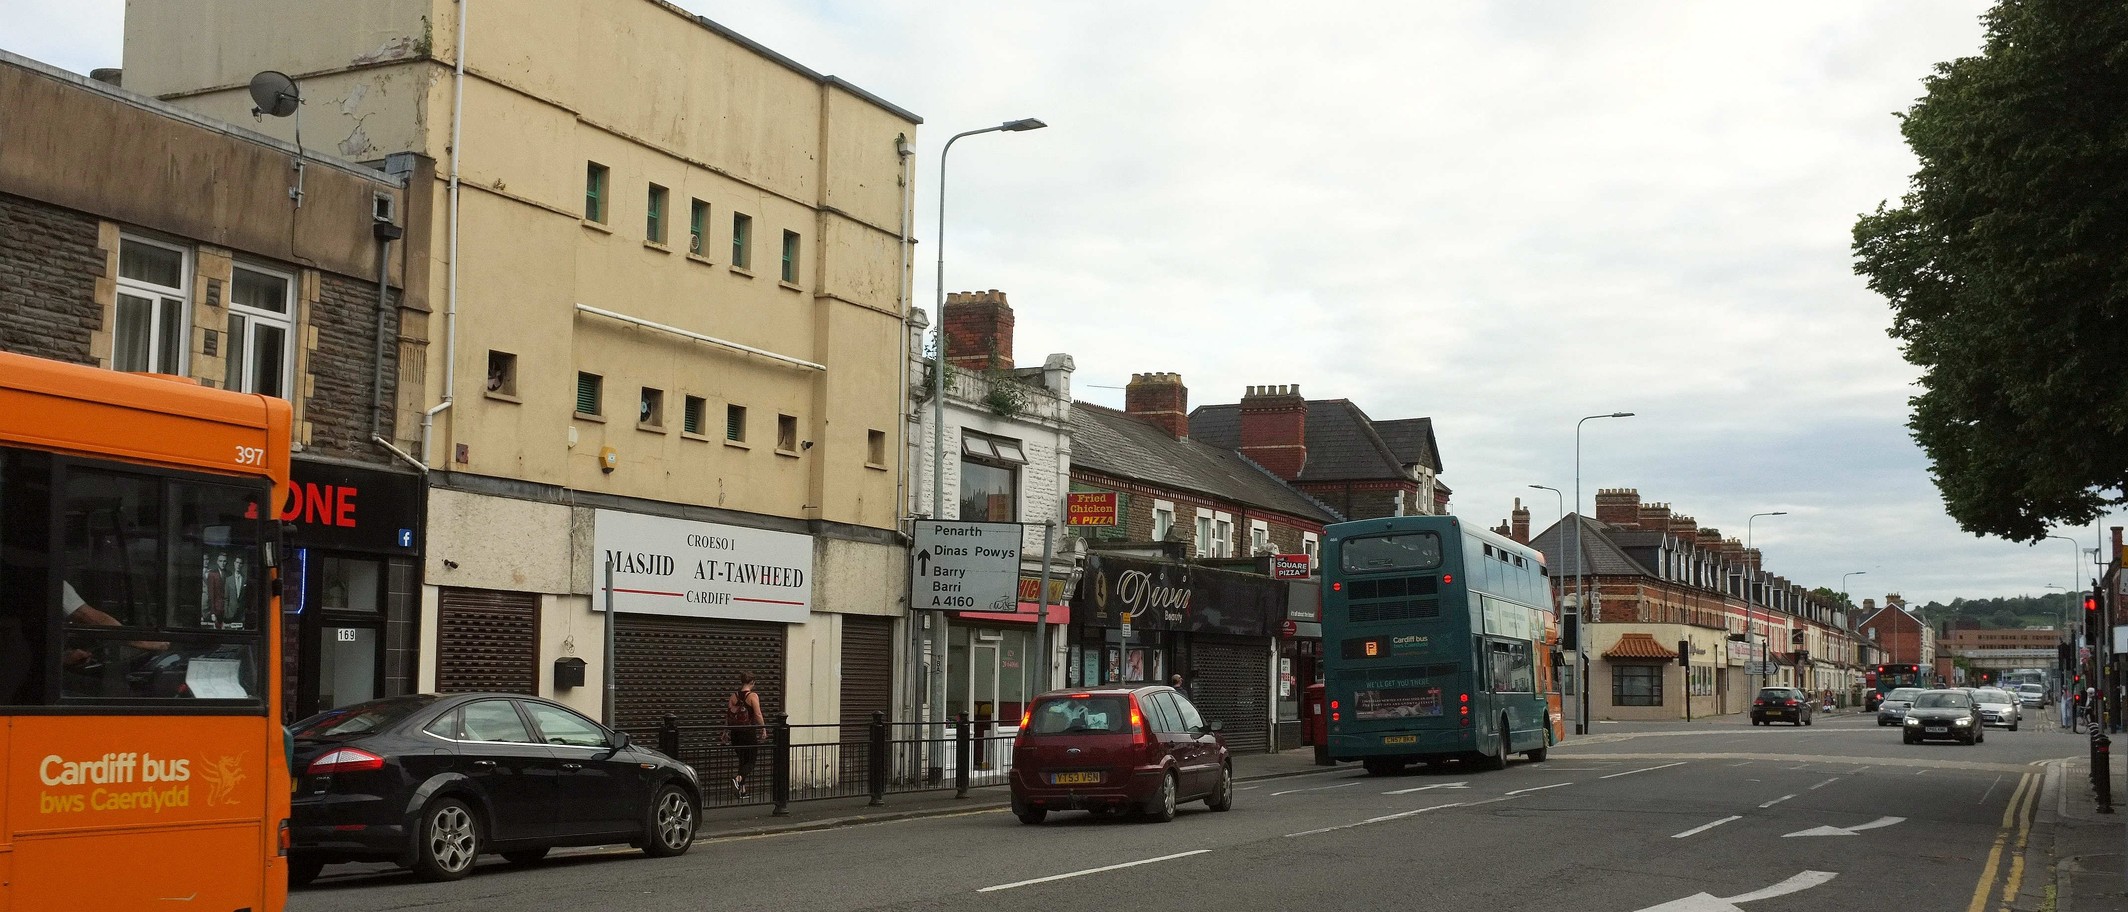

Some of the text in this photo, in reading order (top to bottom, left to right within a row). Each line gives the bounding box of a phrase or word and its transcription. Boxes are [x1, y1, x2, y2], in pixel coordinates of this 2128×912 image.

[235, 446, 264, 466] 397
[1077, 494, 1106, 503] Fried
[1070, 504, 1114, 513] Chicken
[1070, 516, 1114, 525] & PIZZA
[934, 525, 982, 537] Penarth
[687, 534, 735, 551] CROESO I
[934, 545, 1015, 559] Dinas Powys
[605, 549, 804, 588] MASJID AT-TAWHEED
[1276, 561, 1308, 570] SQUARE
[933, 566, 966, 579] Barry
[932, 581, 961, 592] Barri
[686, 590, 731, 605] CARDIFF
[932, 596, 974, 607] A 4160
[1164, 610, 1183, 624] Beauty
[338, 630, 355, 641] 169
[1393, 635, 1415, 644] Cardiff
[39, 752, 191, 786] Cardiff bus
[1056, 772, 1100, 783] YT53 VSN
[40, 785, 189, 814] bws Caerdydd
